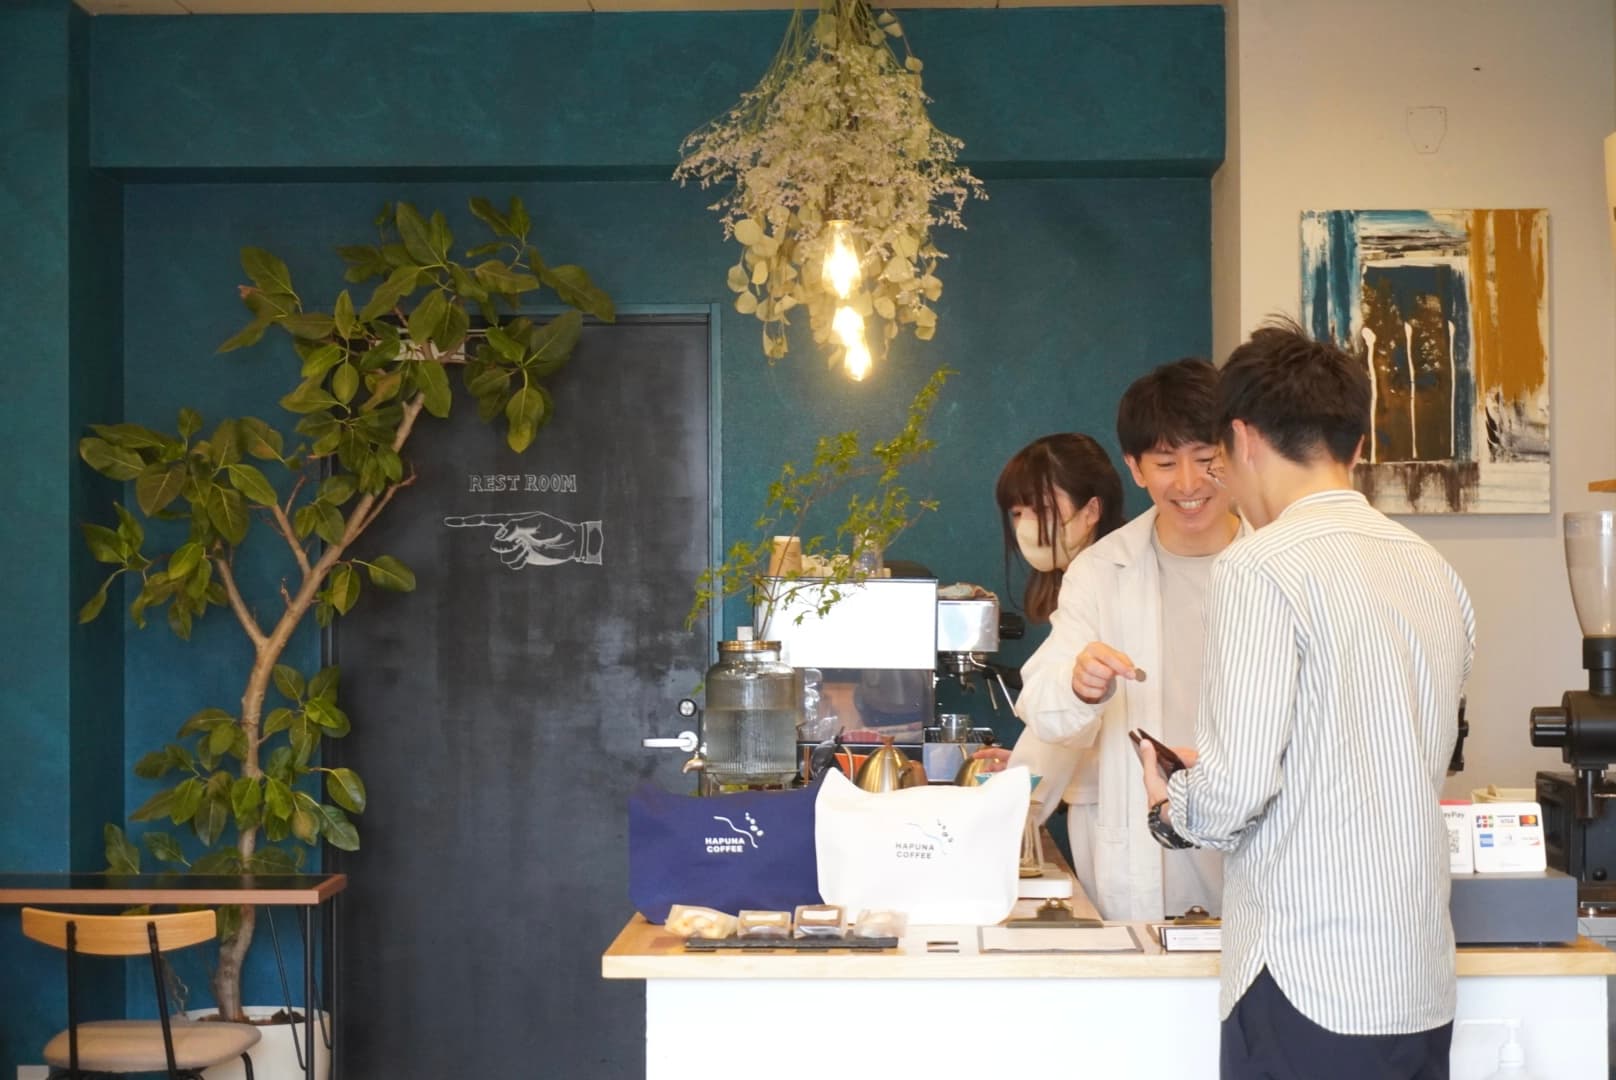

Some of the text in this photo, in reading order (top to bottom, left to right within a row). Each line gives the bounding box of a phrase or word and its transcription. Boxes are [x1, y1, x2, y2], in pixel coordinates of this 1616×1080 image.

[469, 474, 577, 493] REST ROOM
[705, 837, 745, 845] HAPUNA
[706, 845, 743, 853] COFFEE
[896, 842, 934, 851] HAPUNA
[896, 850, 931, 859] COFFEE
